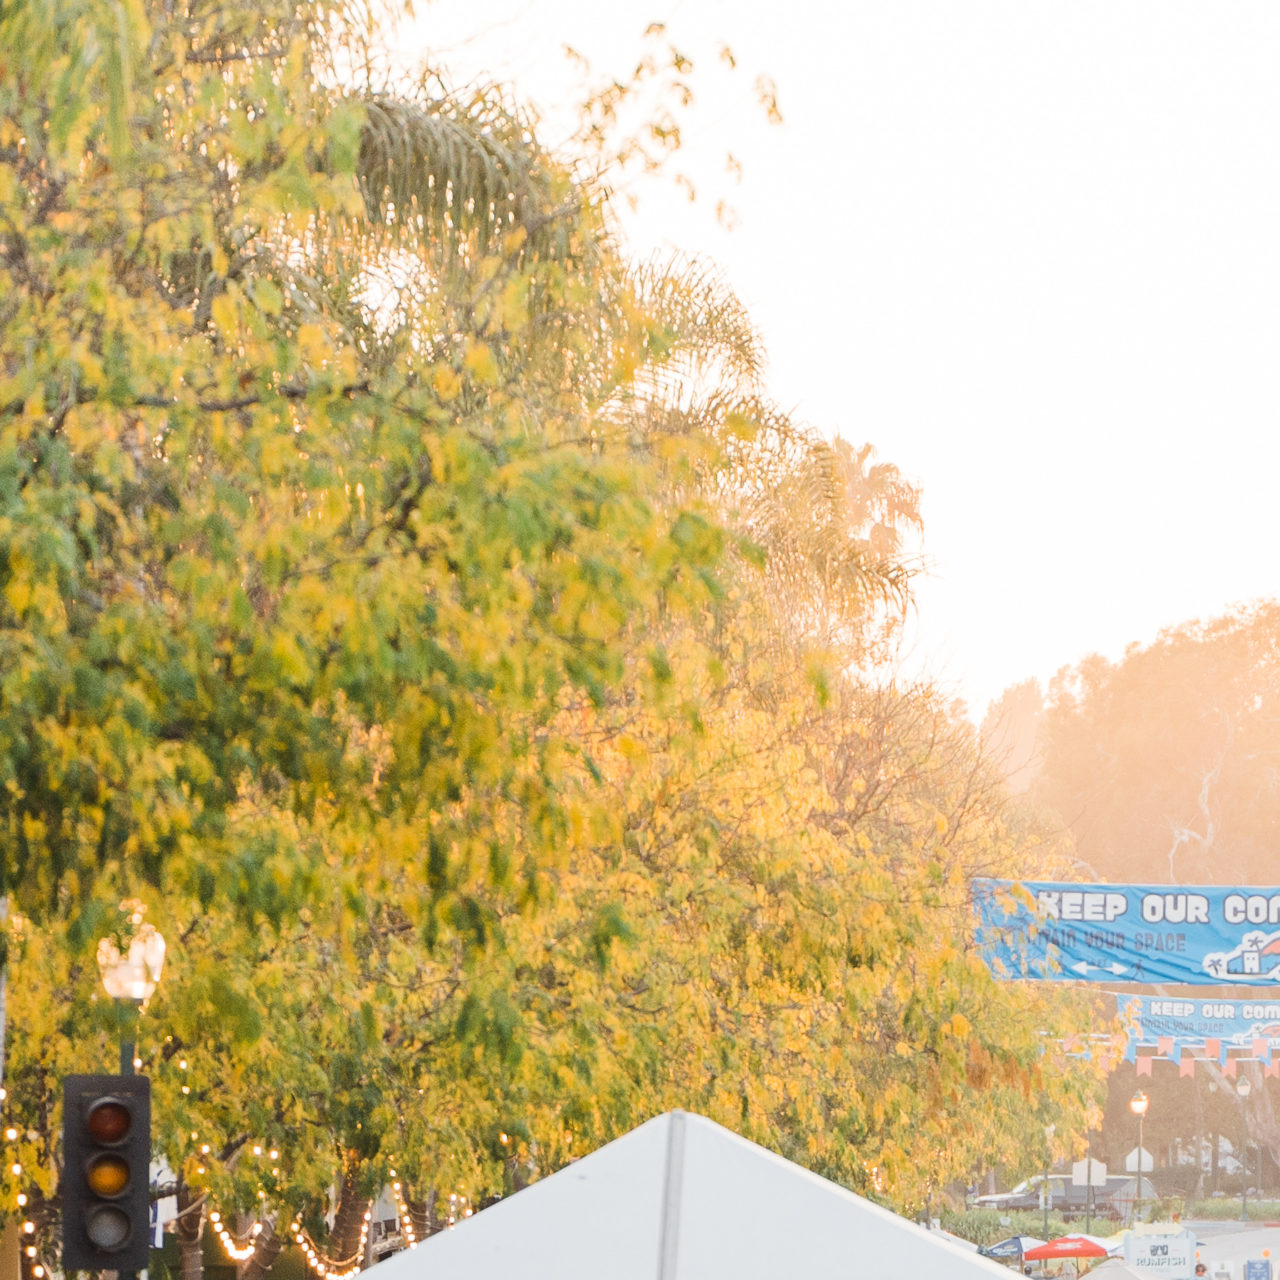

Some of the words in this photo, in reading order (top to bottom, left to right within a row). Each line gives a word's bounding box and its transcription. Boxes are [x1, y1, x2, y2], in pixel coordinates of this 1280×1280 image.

[1037, 891, 1128, 922] KEEP
[1141, 893, 1209, 923] OUR
[1084, 931, 1126, 949] YOUR
[1134, 933, 1186, 952] SPACE
[1150, 1001, 1195, 1017] KEEP
[1202, 1004, 1235, 1019] OUR
